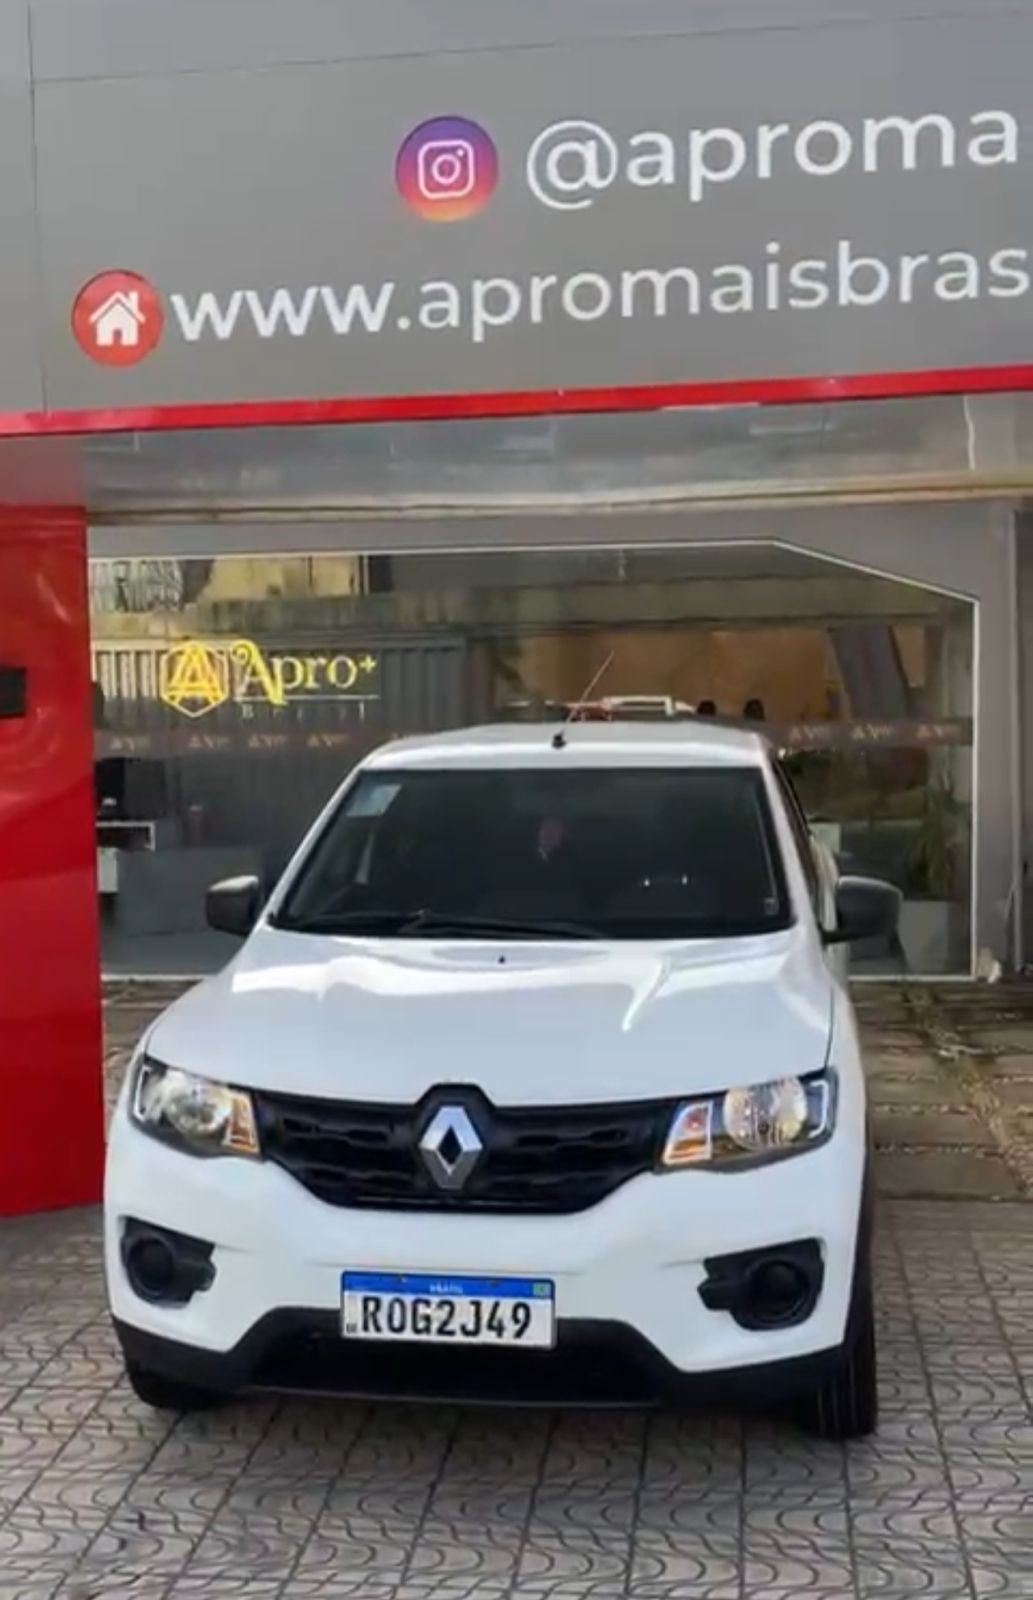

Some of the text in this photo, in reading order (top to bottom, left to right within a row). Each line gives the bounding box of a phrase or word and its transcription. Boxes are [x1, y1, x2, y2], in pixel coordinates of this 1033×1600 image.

[525, 107, 1019, 211] @aproma
[171, 240, 1030, 342] www.apromaisbras
[361, 1296, 531, 1339] ROG2J49
